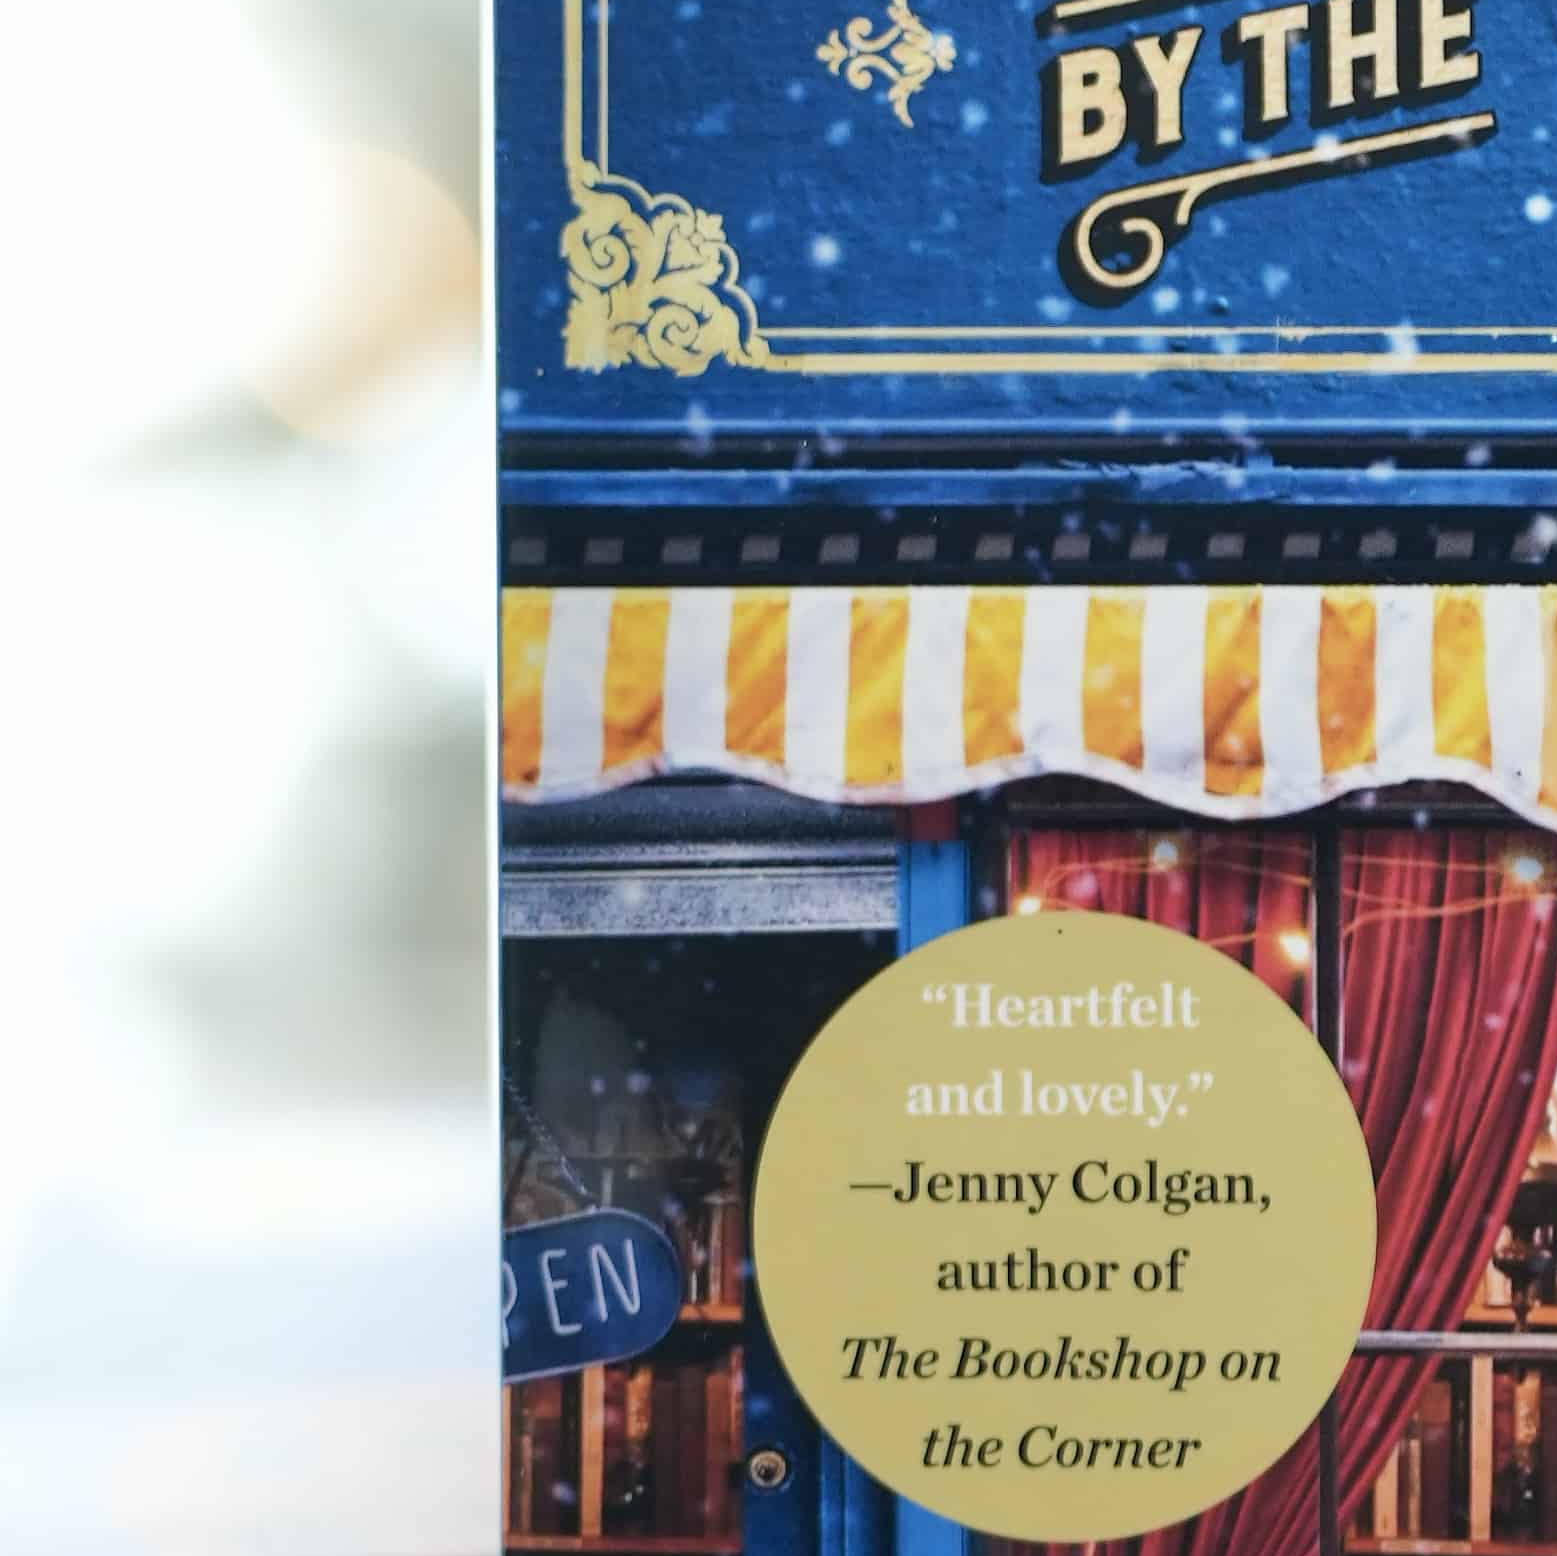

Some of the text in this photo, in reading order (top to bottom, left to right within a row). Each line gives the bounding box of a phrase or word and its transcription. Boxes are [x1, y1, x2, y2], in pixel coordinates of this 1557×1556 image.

[1056, 28, 1202, 163] BY
[920, 980, 1201, 1030] “Heartfelt
[905, 1066, 1216, 1129] and lovely.”
[1071, 1158, 1272, 1216] Colgan,
[936, 1246, 1191, 1292] author of
[841, 1335, 1281, 1393] The Bookshop on
[922, 1423, 1202, 1470] the Corner
